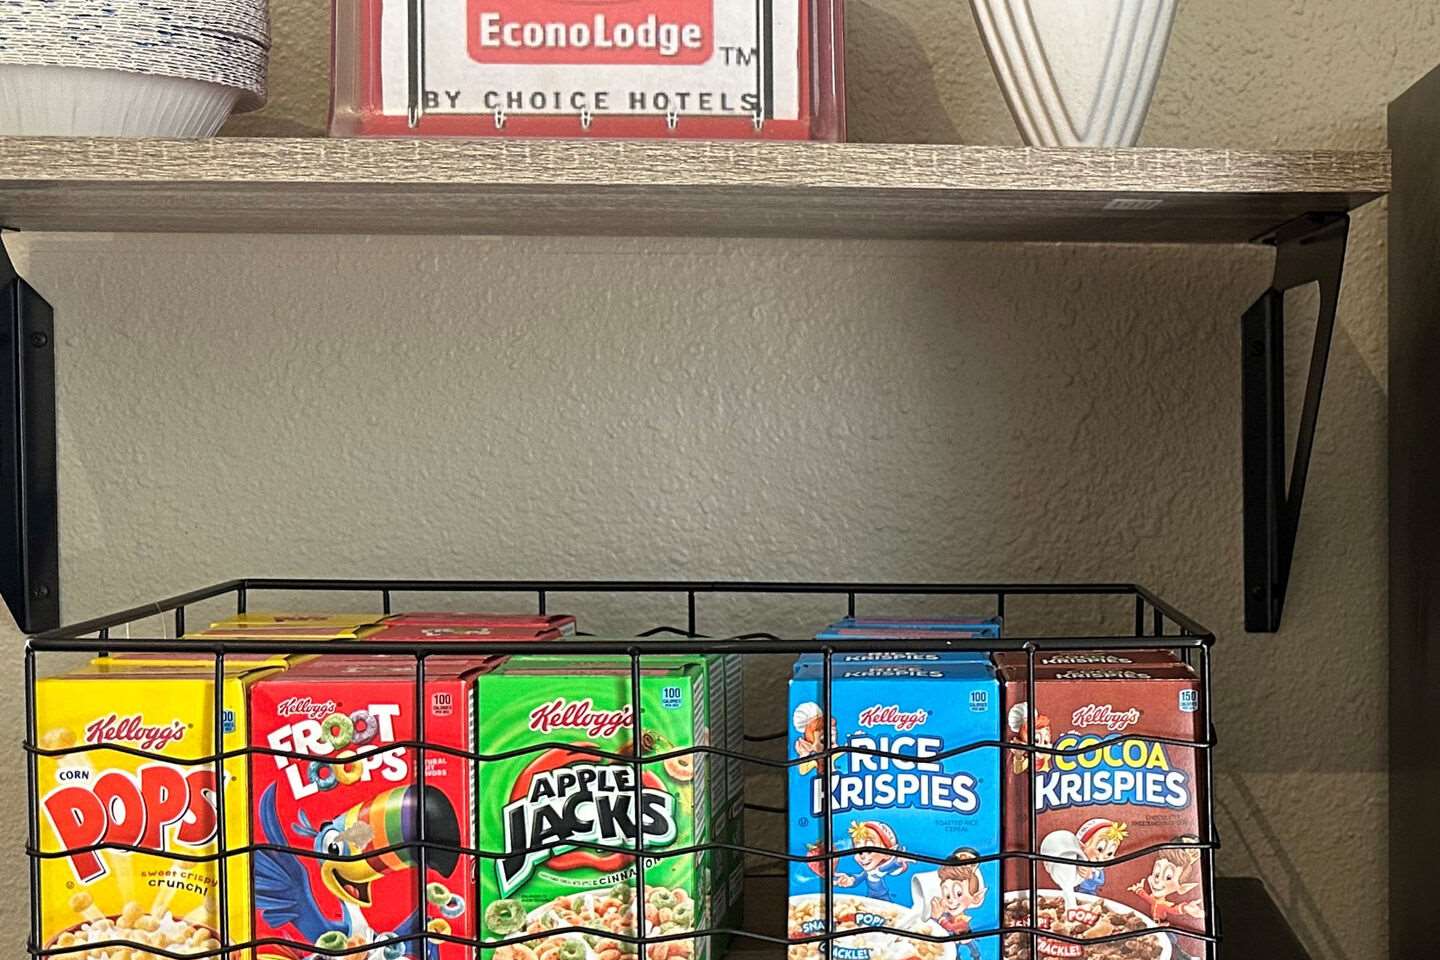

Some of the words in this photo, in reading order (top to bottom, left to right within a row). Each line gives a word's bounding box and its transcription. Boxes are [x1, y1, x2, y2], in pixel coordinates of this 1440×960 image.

[479, 13, 702, 55] EconoLodge
[423, 91, 461, 110] BY
[483, 90, 608, 111] CHOICE
[629, 92, 758, 110] HOTELS
[277, 697, 337, 718] Kellogg's
[858, 705, 927, 730] Kellogg's
[1072, 705, 1139, 730] Kellogg's
[86, 716, 187, 751] Kellogg's
[268, 704, 399, 768] FROOT
[283, 745, 408, 800] LOOPS
[851, 735, 942, 773] RICE
[1055, 737, 1169, 771] COCOA
[59, 769, 90, 781] CORN
[531, 767, 635, 803] APPLE
[813, 773, 979, 814] KRISPIES
[1035, 771, 1188, 809] KRISPIES
[44, 764, 225, 886] POPS
[501, 792, 672, 880] JACKS
